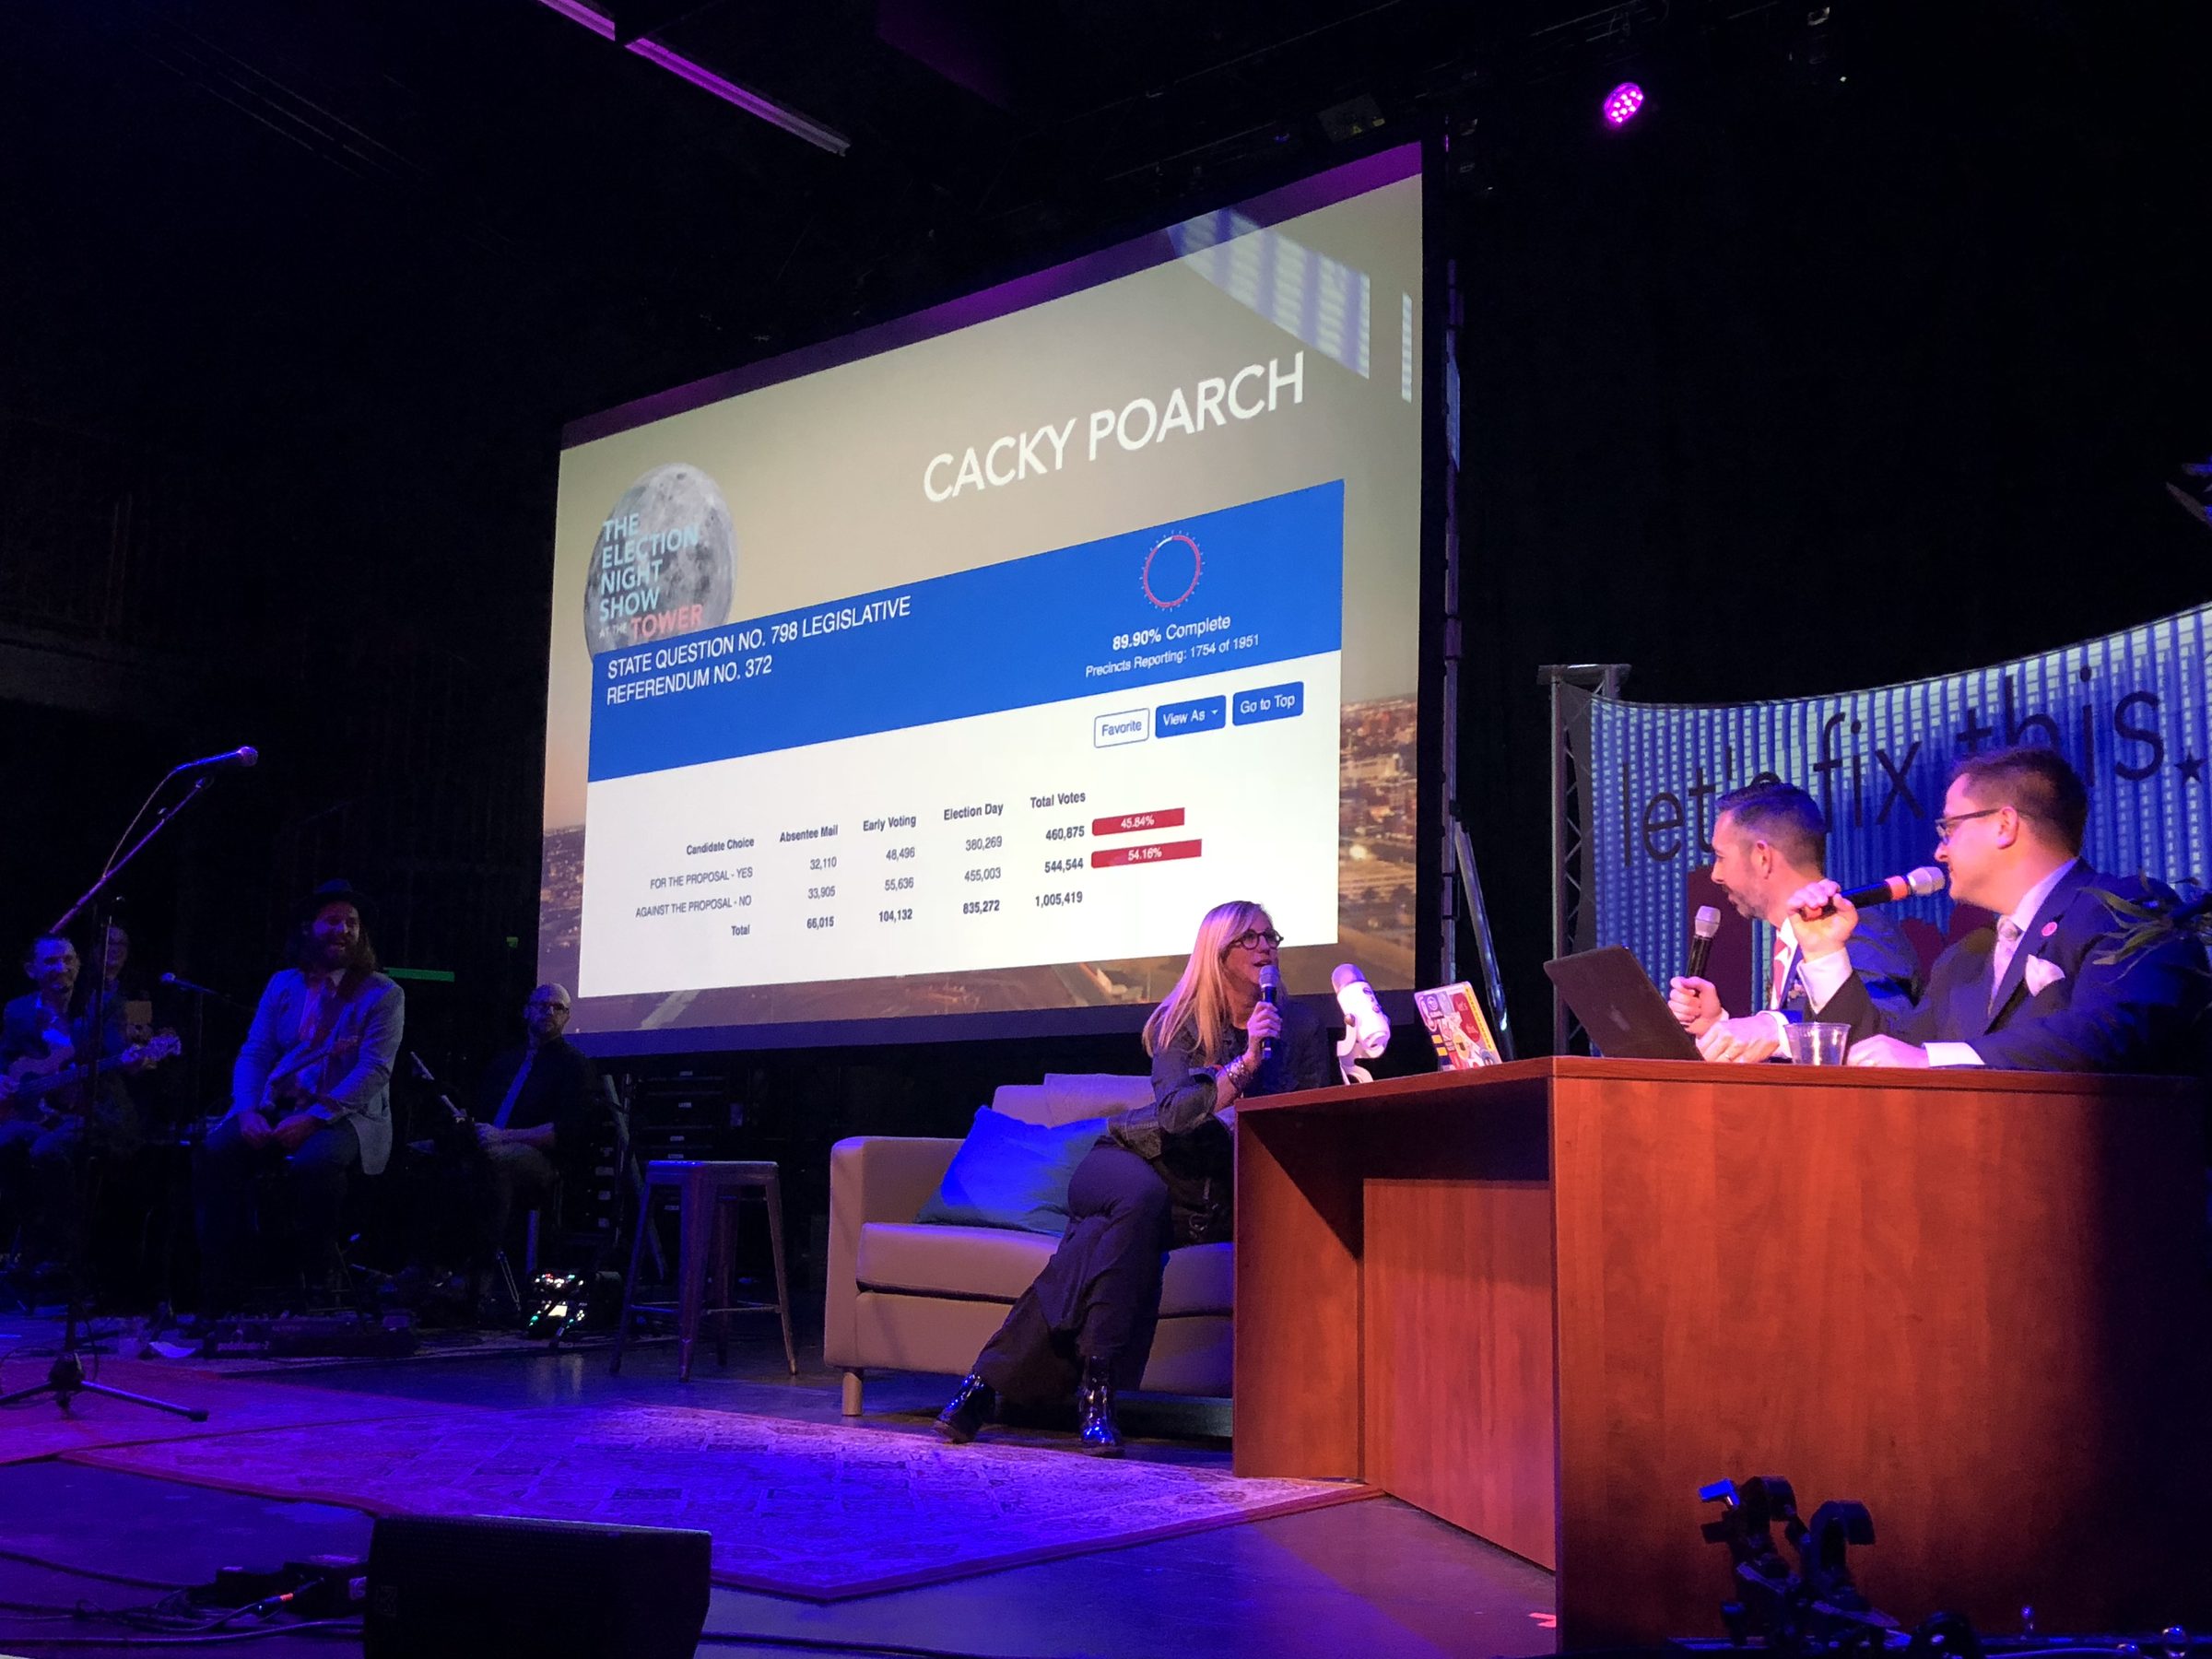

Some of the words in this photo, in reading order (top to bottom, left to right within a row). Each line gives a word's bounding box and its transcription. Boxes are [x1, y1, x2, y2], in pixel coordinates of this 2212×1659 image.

[924, 417, 1077, 502] CACKY
[1088, 350, 1304, 462] POARCH
[603, 512, 640, 542] THE
[602, 522, 700, 570] ELECTION
[601, 559, 664, 595] NIGHT
[599, 586, 660, 622] SHOW
[611, 622, 628, 635] THE
[629, 604, 703, 642] TOWER
[607, 651, 653, 680] STATE
[655, 634, 735, 671] QUESTION
[737, 628, 767, 653] NO.
[771, 620, 798, 644] 798
[802, 595, 912, 639] LEGISLATIVE
[1112, 628, 1162, 651] 89.90%
[1166, 615, 1231, 641] Complete
[1085, 658, 1131, 678] Precincts
[1134, 648, 1187, 669] Reporting:
[1190, 643, 1217, 658] 1754
[1218, 639, 1230, 653] of
[1233, 633, 1260, 650] 1951
[606, 666, 710, 706] REFERENDUM
[713, 661, 741, 686] NO.
[745, 654, 773, 679] 372
[1240, 700, 1257, 715] Go
[1260, 698, 1271, 711] to
[1274, 693, 1296, 710] Top
[1163, 712, 1187, 727] View
[1190, 709, 1206, 723] As
[1101, 719, 1142, 737] Favorite
[1622, 747, 1782, 868] let'
[1813, 712, 1924, 833] fix
[1030, 794, 1054, 808] Total
[1057, 792, 1086, 806] Votes
[944, 806, 982, 820] Election
[984, 803, 1004, 817] Day
[863, 818, 886, 832] Early
[888, 815, 917, 829] Voting
[1121, 815, 1155, 830] 45.84%
[780, 829, 819, 842] Absentee
[820, 824, 839, 837] Mail
[1045, 826, 1085, 841] 460,875
[686, 841, 725, 856] Candidate
[727, 837, 755, 850] Choice
[965, 835, 1003, 852] 380,269
[886, 846, 915, 862] 48,496
[1127, 847, 1163, 862] 54.16%
[809, 856, 837, 871] 32,110
[1044, 858, 1084, 874] 544,544
[650, 877, 667, 889] FOR
[668, 875, 684, 888] THE
[686, 870, 730, 886] PROPOSAL
[736, 866, 753, 879] YES
[964, 866, 1001, 882] 455,003
[807, 885, 836, 900] 33,905
[884, 877, 914, 892] 55,636
[635, 903, 670, 918] AGAINST
[671, 900, 687, 914] THE
[688, 895, 732, 912] PROPOSAL
[738, 895, 752, 907] NO
[963, 900, 1000, 914] 835,272
[1035, 890, 1083, 908] 1,005,419
[806, 916, 834, 930] 66,015
[878, 909, 912, 924] 104,132
[731, 924, 750, 936] Total
